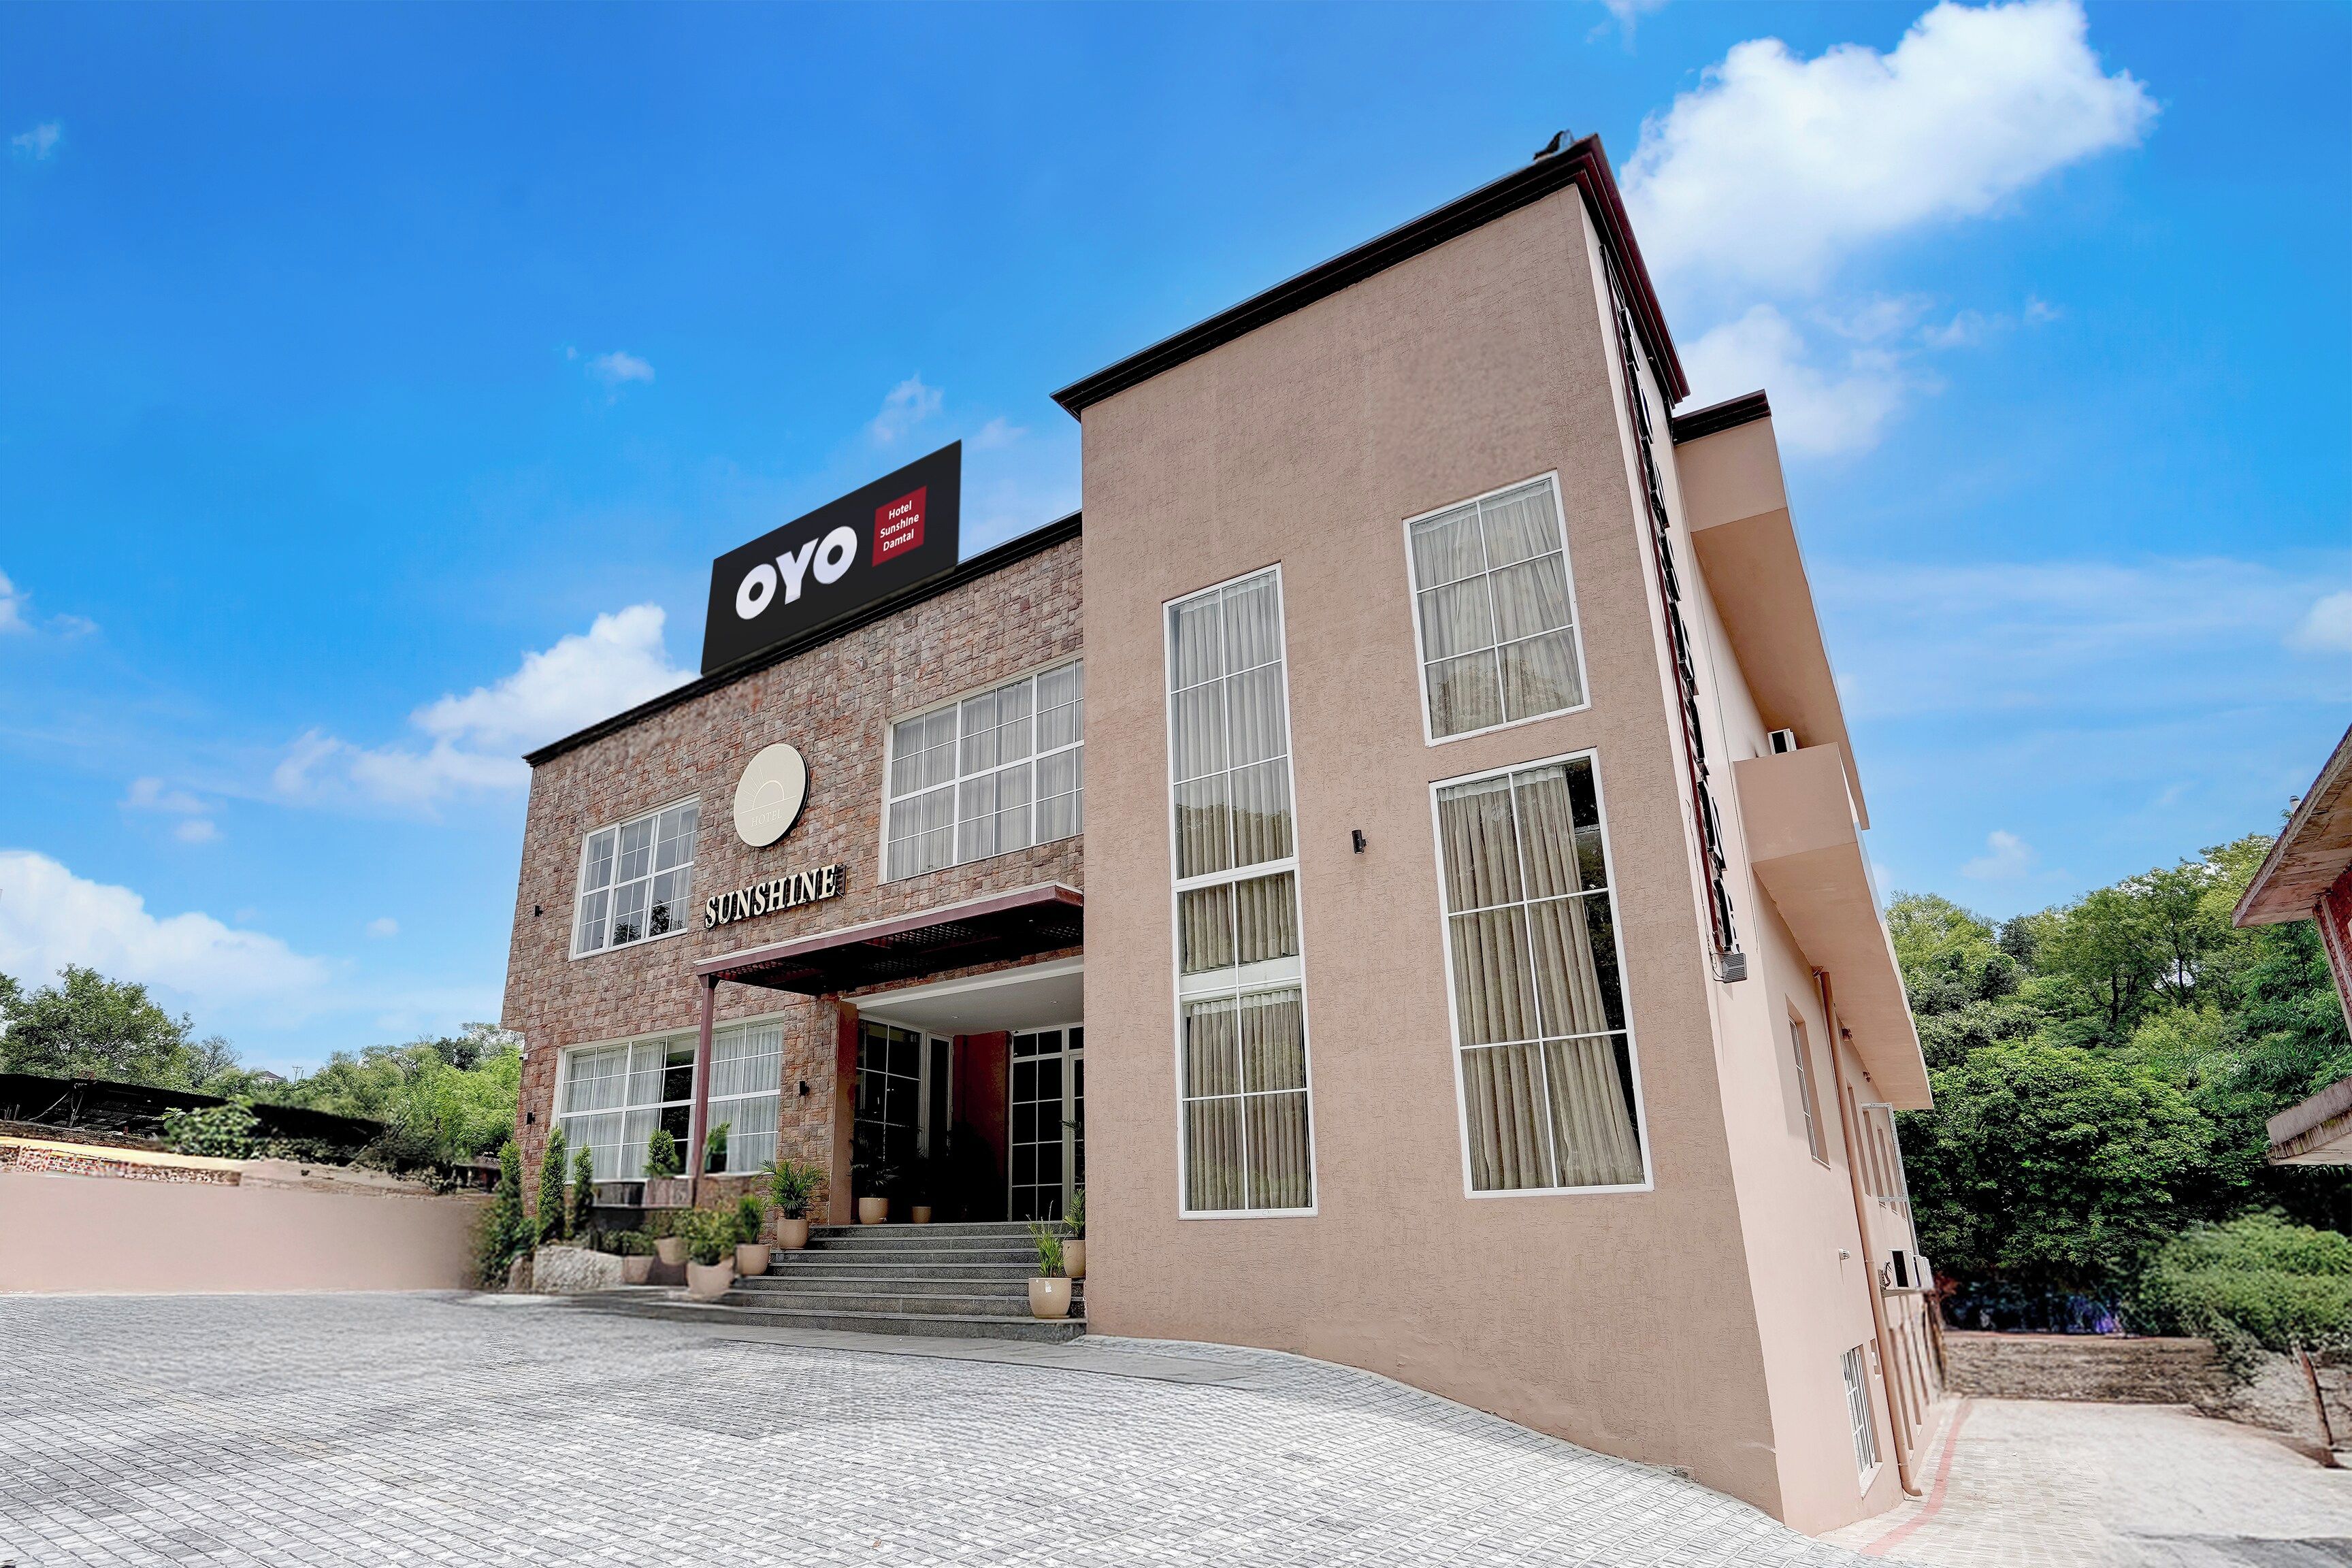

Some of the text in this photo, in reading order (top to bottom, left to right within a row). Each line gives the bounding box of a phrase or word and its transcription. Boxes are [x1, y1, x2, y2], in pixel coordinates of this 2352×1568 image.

[888, 500, 912, 520] Hotel
[879, 514, 919, 538] Sunshine
[883, 528, 915, 552] Damtal
[735, 525, 858, 620] OYO
[751, 809, 783, 828] HOTEL
[704, 863, 837, 928] SUNSHINE
